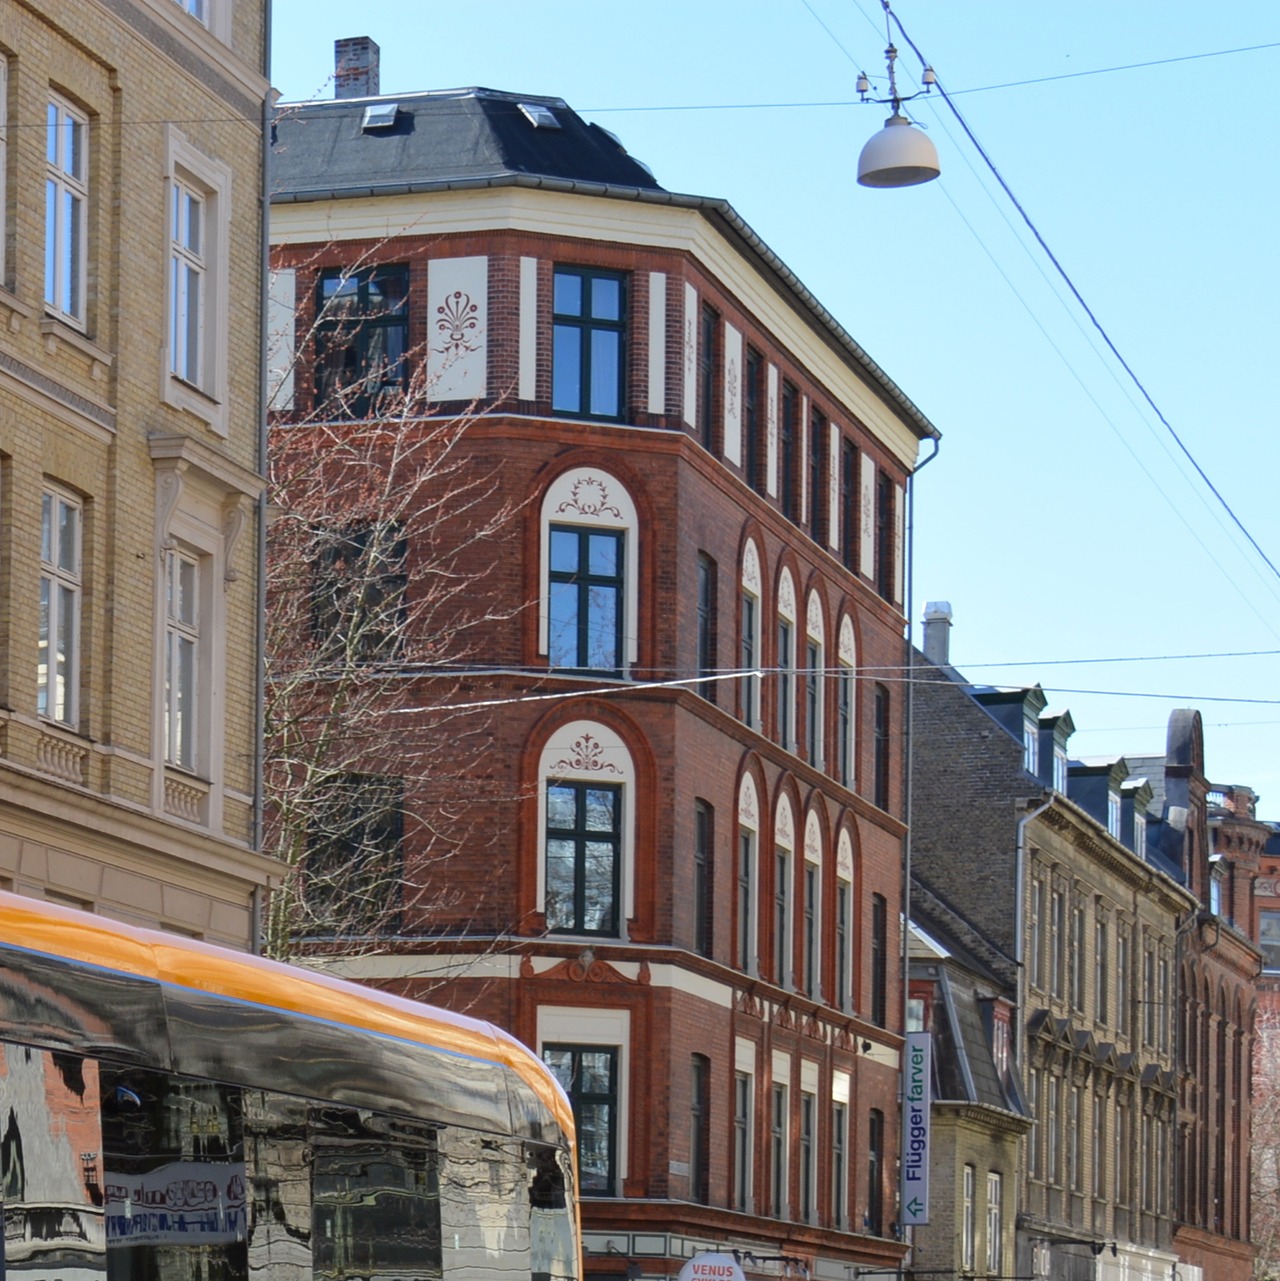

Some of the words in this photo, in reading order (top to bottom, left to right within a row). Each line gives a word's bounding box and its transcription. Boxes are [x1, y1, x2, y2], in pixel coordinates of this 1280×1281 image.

[907, 1045, 924, 1102] farver
[906, 1106, 926, 1182] Flügger
[692, 1264, 733, 1277] VENUS
